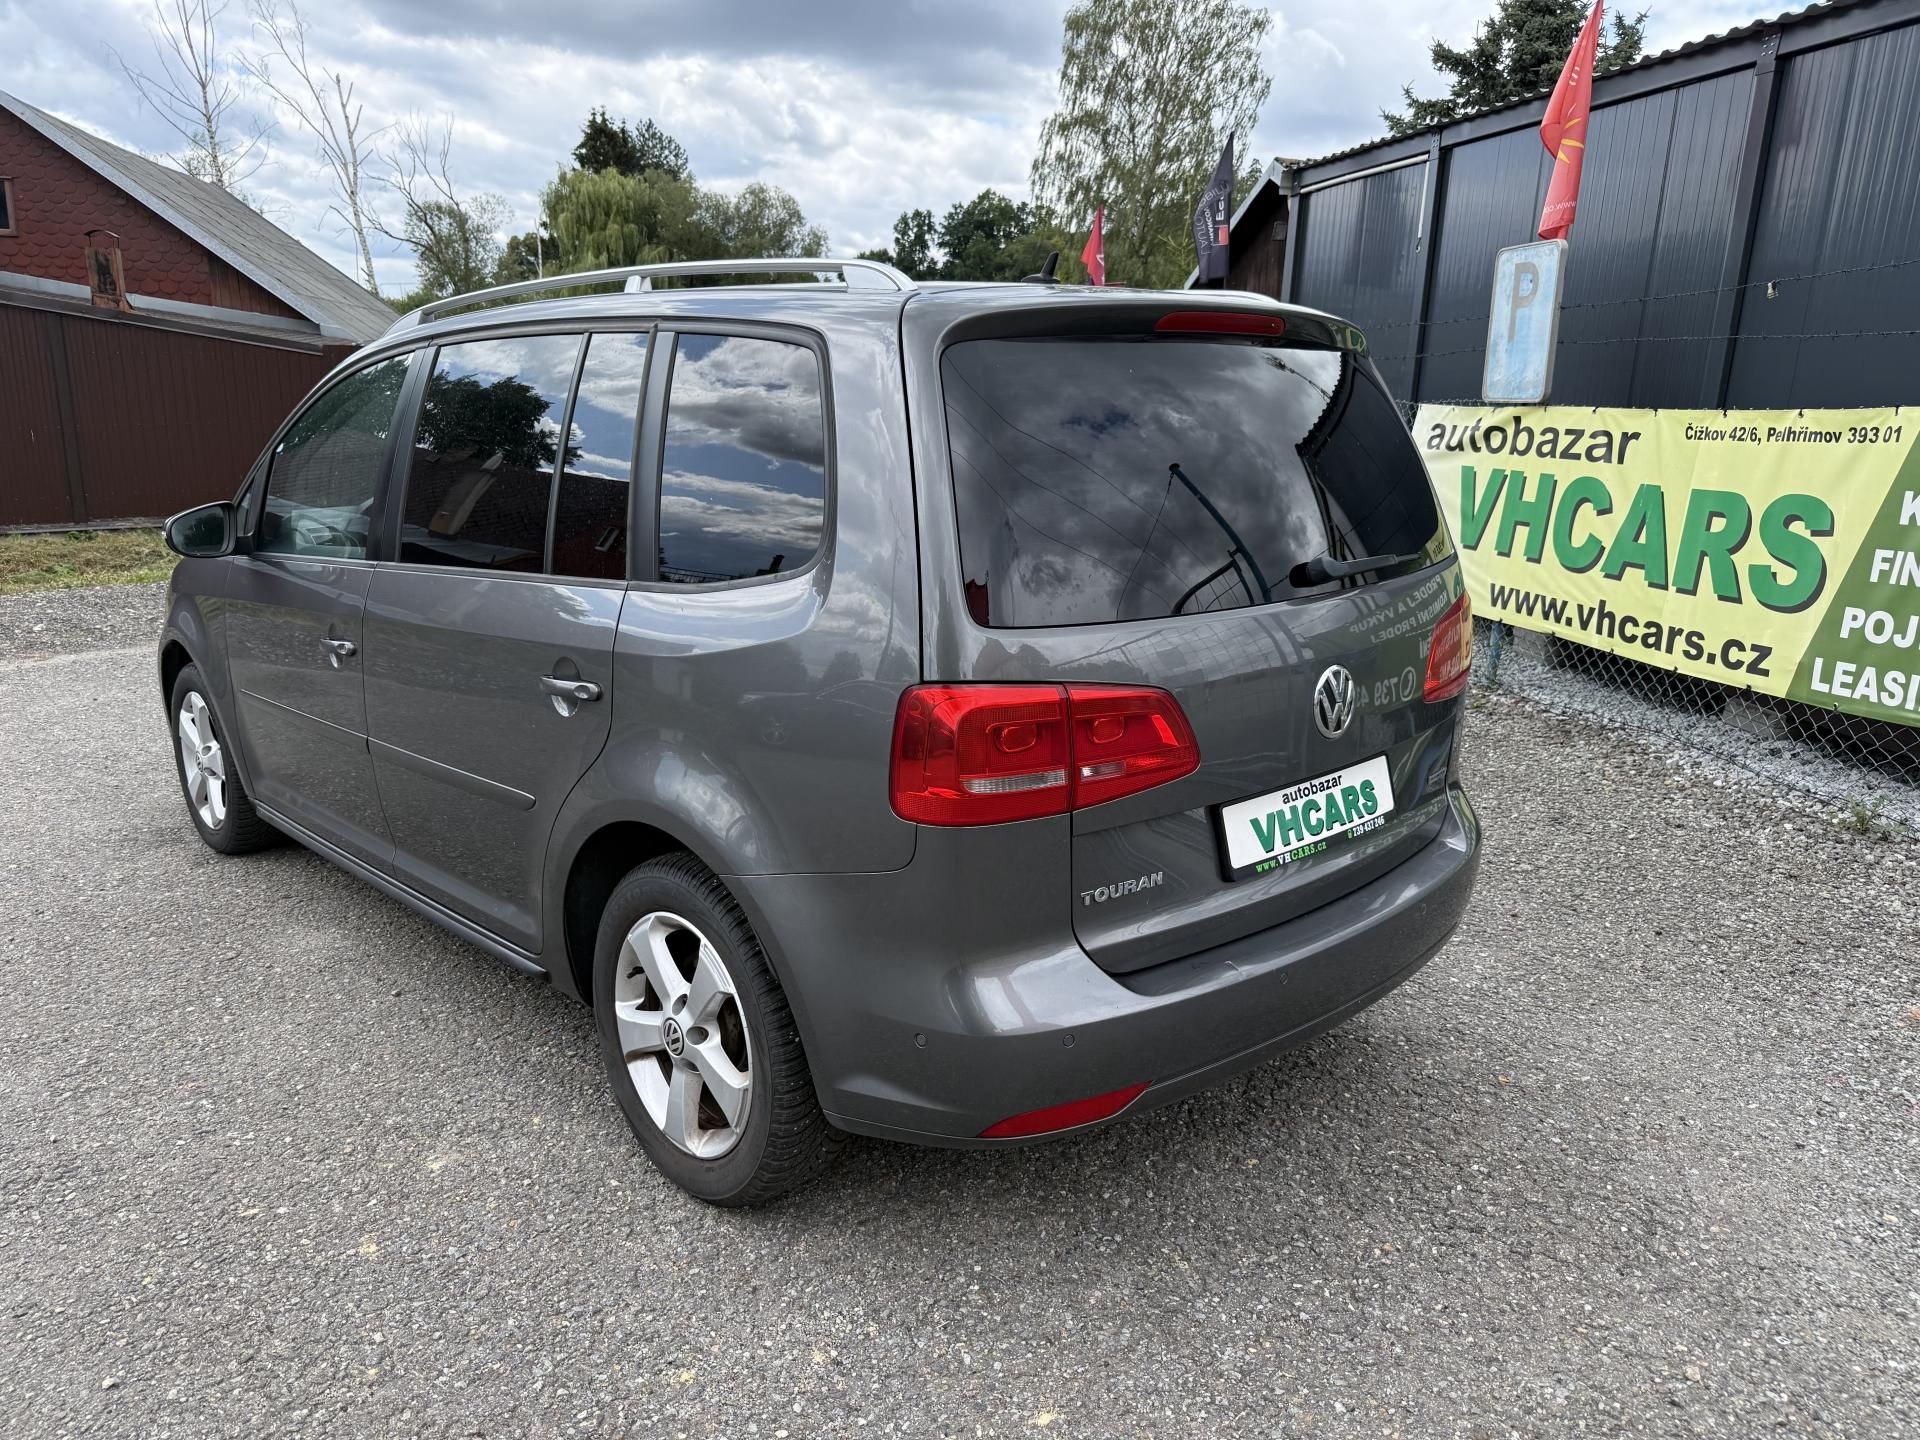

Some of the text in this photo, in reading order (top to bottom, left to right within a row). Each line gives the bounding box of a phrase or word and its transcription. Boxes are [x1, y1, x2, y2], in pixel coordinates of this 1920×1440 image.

[1508, 261, 1539, 341] P
[1426, 415, 1642, 466] autobazar
[1685, 422, 1903, 446] Čížkov 42/6, Pelhřimov 393 01
[1460, 464, 1835, 614] VHCARS
[1489, 583, 1774, 678] www.vhcars.cz
[1839, 606, 1920, 652] POJ
[1810, 657, 1920, 712] LEASI
[1250, 779, 1378, 853] VHCARS
[1282, 775, 1343, 804] autobazar
[1080, 871, 1163, 906] TOURAN
